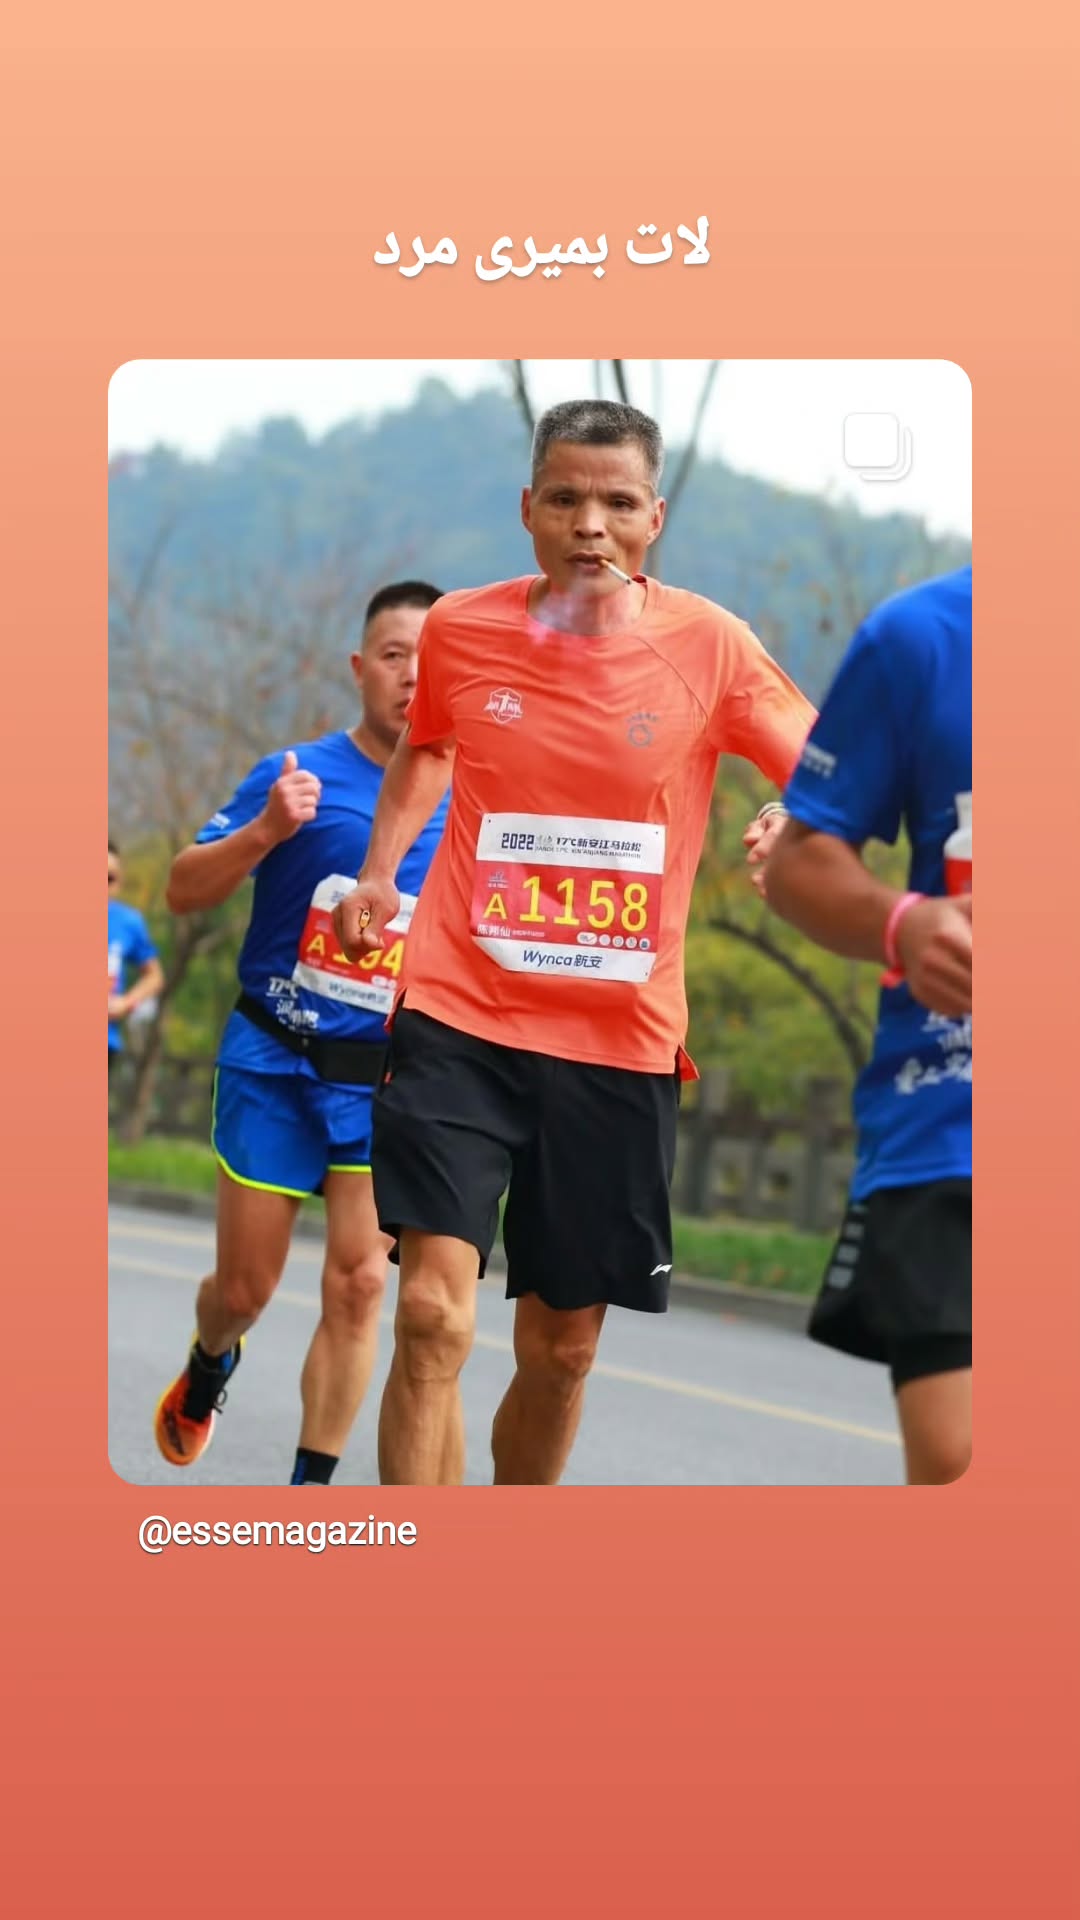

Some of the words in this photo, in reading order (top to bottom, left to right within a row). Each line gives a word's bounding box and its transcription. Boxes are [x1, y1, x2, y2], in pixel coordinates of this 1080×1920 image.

[501, 833, 535, 851] 2022
[483, 892, 508, 920] A
[519, 875, 648, 933] 1158
[306, 934, 326, 957] A
